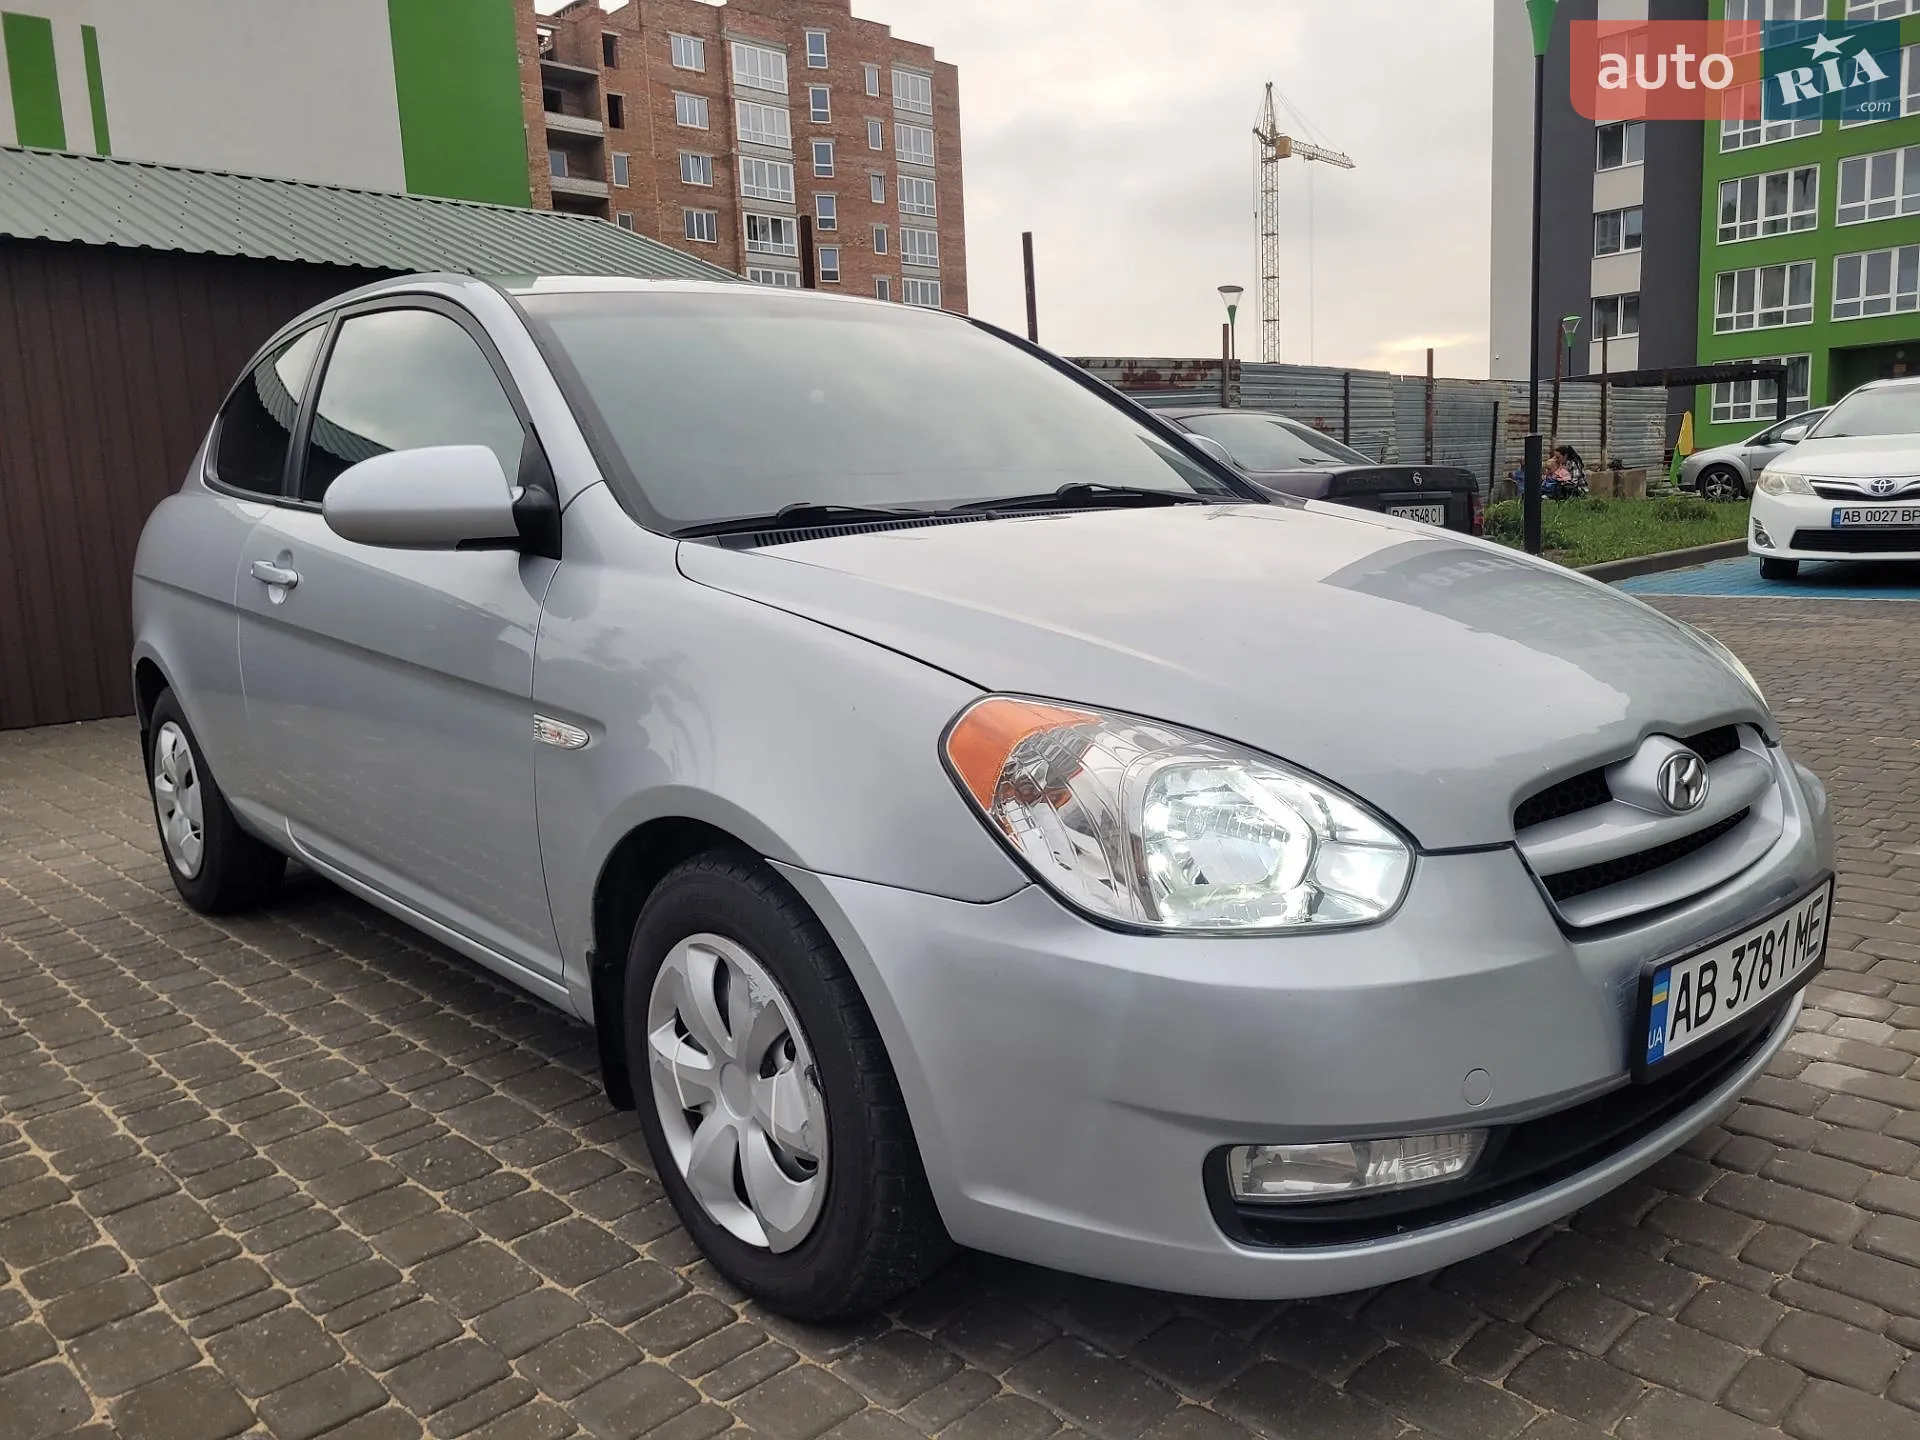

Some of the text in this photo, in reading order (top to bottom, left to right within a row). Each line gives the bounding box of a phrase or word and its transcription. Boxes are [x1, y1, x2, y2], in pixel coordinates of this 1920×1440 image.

[1409, 508, 1430, 523] 3548
[1842, 510, 1861, 523] AB
[1865, 510, 1898, 522] 0027
[1669, 894, 1824, 1041] AB 3781 ME
[1647, 1025, 1663, 1049] UA
